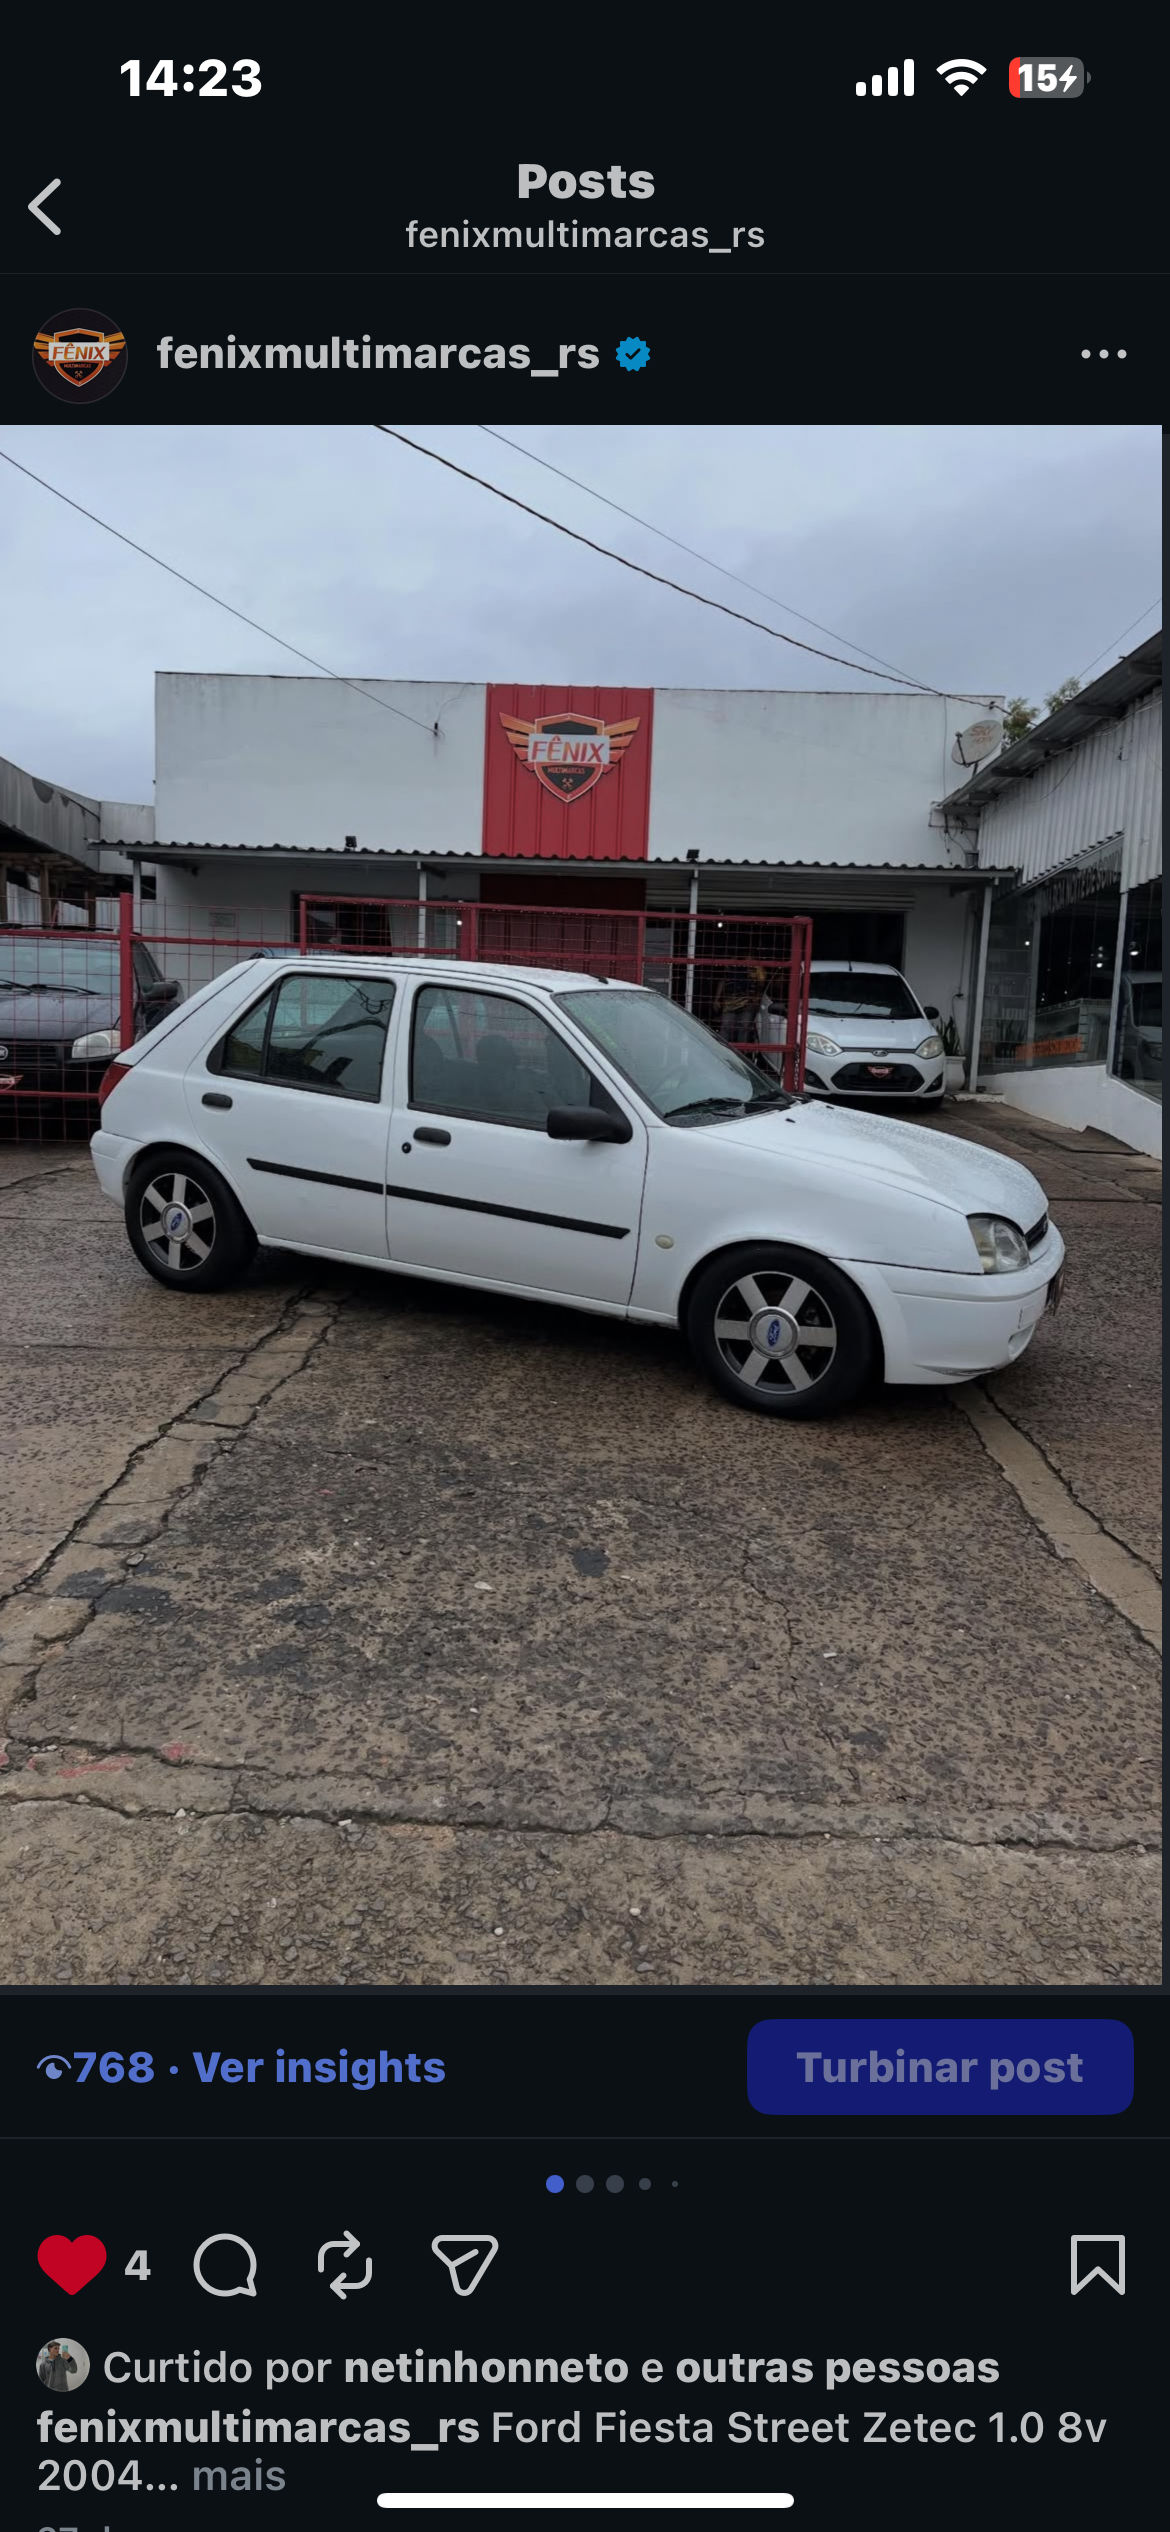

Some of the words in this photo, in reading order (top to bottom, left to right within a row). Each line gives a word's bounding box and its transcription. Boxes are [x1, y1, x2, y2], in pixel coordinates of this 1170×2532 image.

[121, 59, 262, 97] 14:23
[1018, 63, 1058, 92] 15
[519, 164, 655, 199] Posts
[406, 219, 764, 253] fenixmultimarcas_rs
[52, 343, 106, 360] FÊNIX
[157, 334, 599, 377] fenixmultimarcas_rs
[530, 735, 605, 763] FÊNIX
[73, 2051, 154, 2083] 768
[192, 2051, 264, 2083] Ver
[276, 2048, 445, 2090] insights
[797, 2049, 978, 2082] Turbinar
[991, 2054, 1083, 2090] post
[125, 2250, 151, 2280] 4
[104, 2349, 252, 2384] Curtido
[267, 2358, 332, 2391] por
[345, 2348, 628, 2384] netinhonneto
[642, 2358, 663, 2384] e
[676, 2353, 813, 2384] outras
[827, 2358, 999, 2391] pessoas
[37, 2408, 479, 2451] fenixmultimarcas_rs
[493, 2410, 580, 2444] Ford
[596, 2410, 712, 2444] Fiesta
[728, 2410, 849, 2444] Street
[864, 2411, 976, 2444] Zetec
[989, 2411, 1043, 2444] 1.0
[1058, 2411, 1107, 2444] 8v
[38, 2459, 178, 2492] 2004...
[194, 2458, 286, 2492] mais
